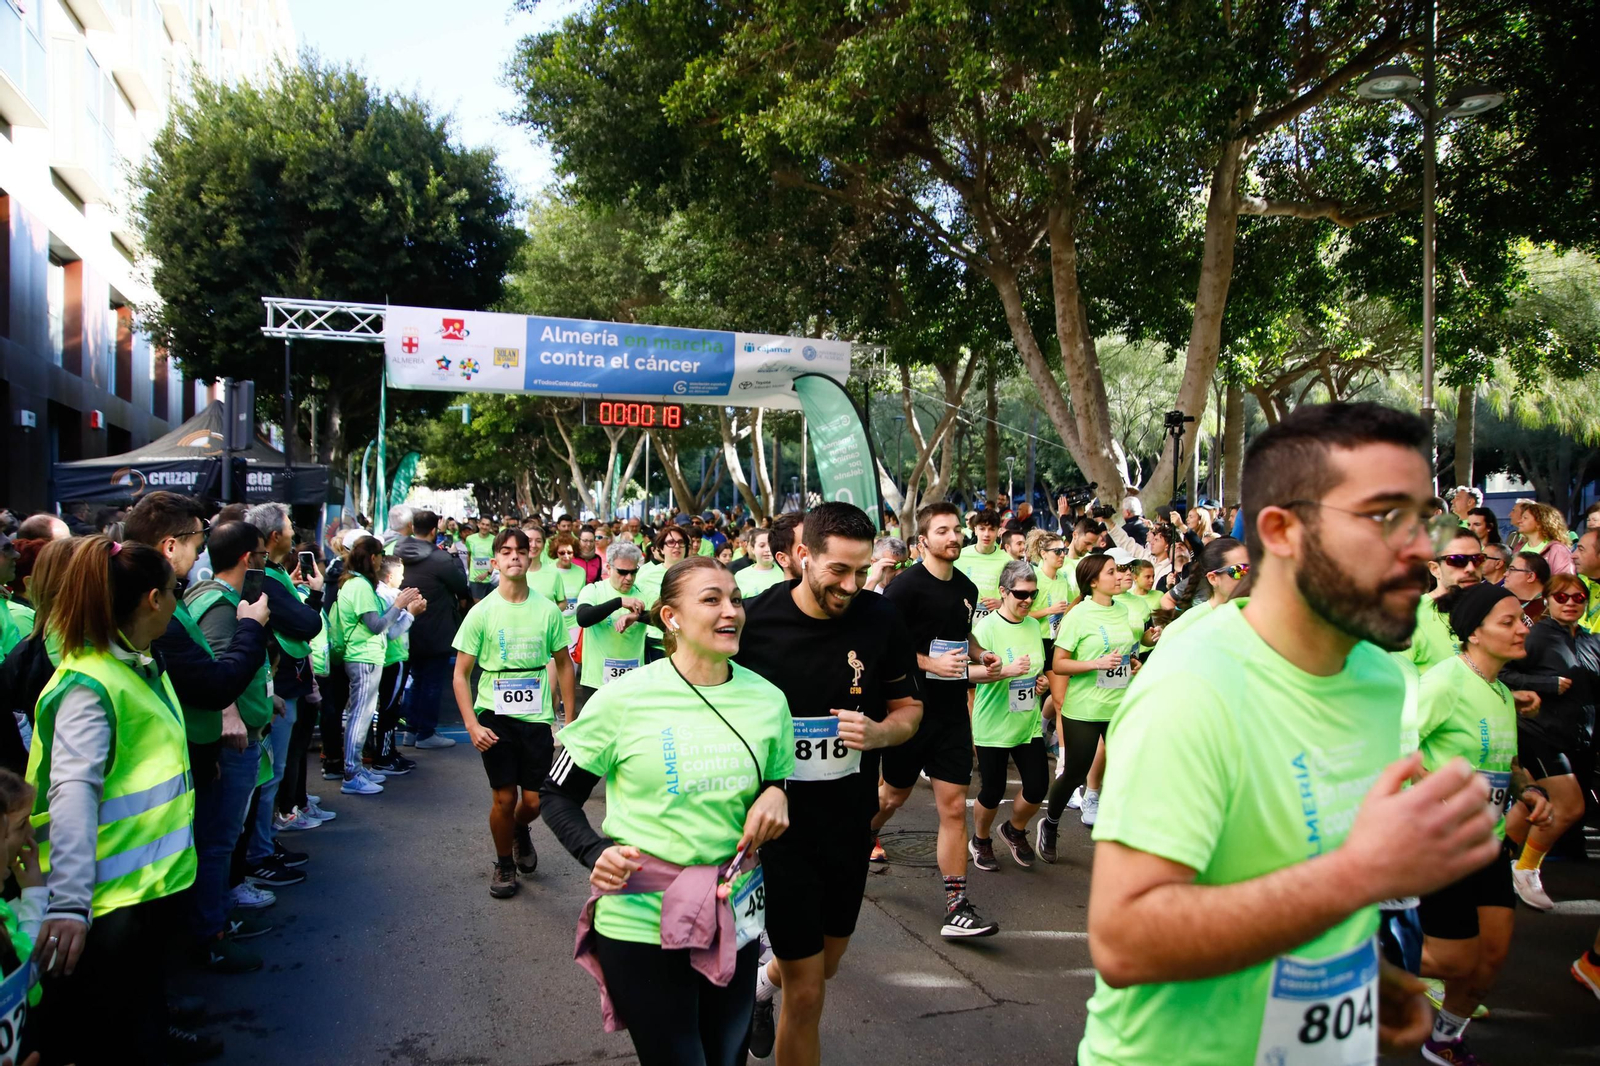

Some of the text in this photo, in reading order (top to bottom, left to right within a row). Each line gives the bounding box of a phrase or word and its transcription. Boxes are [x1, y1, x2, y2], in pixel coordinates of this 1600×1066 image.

[540, 326, 723, 353] Almería en marcha
[540, 350, 701, 373] contra el cáncer
[149, 471, 272, 486] cruzar eta
[499, 629, 507, 660] ALMERÍA
[1099, 625, 1110, 649] LMERÍA
[1106, 666, 1127, 678] 841
[503, 690, 533, 703] 603
[679, 742, 699, 756] En
[795, 738, 848, 760] 818
[1478, 718, 1489, 763] ALMERÍA
[660, 727, 679, 795] ALMERÍA
[682, 755, 740, 773] contra
[683, 773, 756, 793] cáncer
[1292, 752, 1322, 859] LMERÍA
[1298, 986, 1373, 1044] 804
